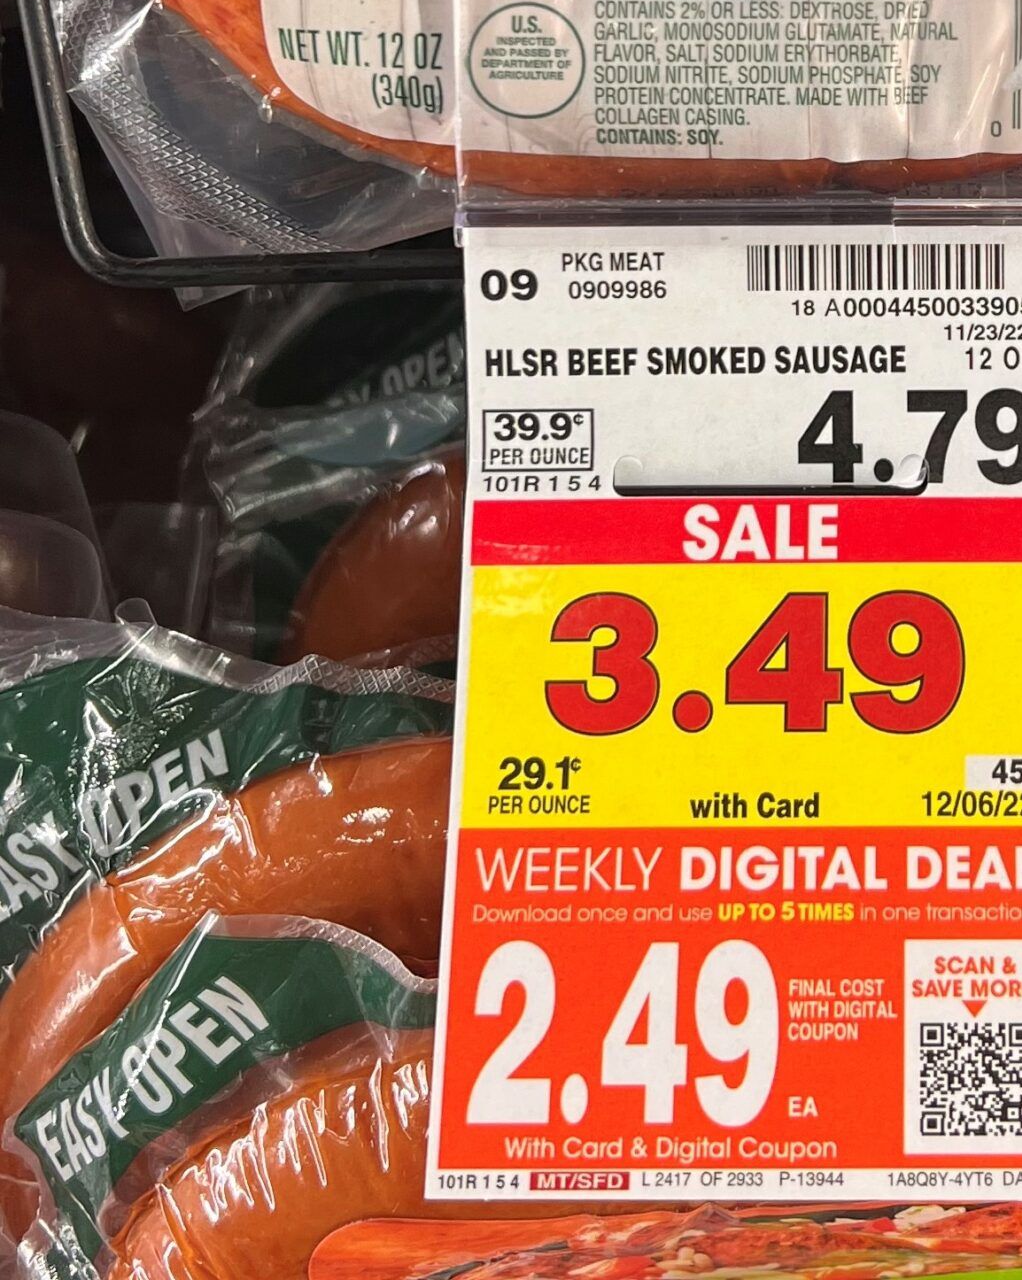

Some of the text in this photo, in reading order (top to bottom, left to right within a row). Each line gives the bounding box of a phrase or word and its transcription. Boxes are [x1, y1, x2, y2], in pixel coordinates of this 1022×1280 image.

[594, 1, 878, 21] CONTAINS 2% OR LESS: DEXTROSE,
[511, 16, 542, 33] U.S.
[594, 21, 958, 43] GARLIC, MONOSODIUM GLUTAMATE, NATURAL
[278, 28, 443, 70] NET WT. 12 OZ
[496, 37, 556, 46] INSPECTED
[484, 48, 569, 57] AND PASSED BY
[594, 44, 902, 64] FLAVOR, SALT, SODIUM ERYTHORBATE,
[481, 59, 571, 69] DEPARTMENT OF
[489, 70, 564, 80] AGRICULTURE
[594, 64, 942, 86] SODIUM NITRITE, SODIUM PHOSPHATE, SOY
[371, 73, 443, 114] (340g)
[594, 86, 929, 106] PROTEIN CONCENTRATE. MADE WITH BEEF
[595, 108, 750, 126] COLLAGEN CASING.
[596, 128, 723, 146] CONTAINS: SOY.
[562, 252, 665, 272] PKG MEAT
[480, 269, 539, 301] 09
[568, 280, 667, 300] 0909986
[484, 344, 907, 377] HLSR BEEF SMOKED SAUSAGE
[965, 348, 992, 370] 12
[490, 447, 589, 465] PER OUNCE
[482, 476, 540, 493] 101R
[682, 504, 838, 561] SALE
[544, 590, 966, 736] 3.49
[488, 794, 590, 814] PER OUNCE
[690, 792, 820, 818] with Card
[0, 729, 229, 920] ASY OPEN
[475, 846, 663, 891] WEEKLY
[680, 845, 888, 891] DIGITAL
[472, 903, 572, 922] Download
[578, 907, 627, 922] once
[633, 903, 673, 921] and
[679, 907, 712, 921] use
[718, 903, 745, 921] UP
[749, 903, 775, 921] TO
[781, 901, 795, 920] 5
[798, 902, 854, 920] TIMES
[860, 903, 876, 920] in
[882, 906, 920, 920] one
[934, 956, 1017, 975] SCAN &
[788, 978, 884, 997] FINAL COST
[912, 979, 963, 998] SAVE
[788, 1000, 898, 1019] WITH DIGITAL
[466, 939, 780, 1128] 2.49
[788, 1022, 858, 1041] COUPON
[36, 975, 269, 1181] EASY OPEN
[788, 1096, 819, 1117] EA
[504, 1136, 837, 1164] With Card & Digital Coupon
[438, 1174, 477, 1190] 101R
[537, 1172, 623, 1190] MT/SFD
[655, 1171, 844, 1187] 2417 OF 2933 P-13944
